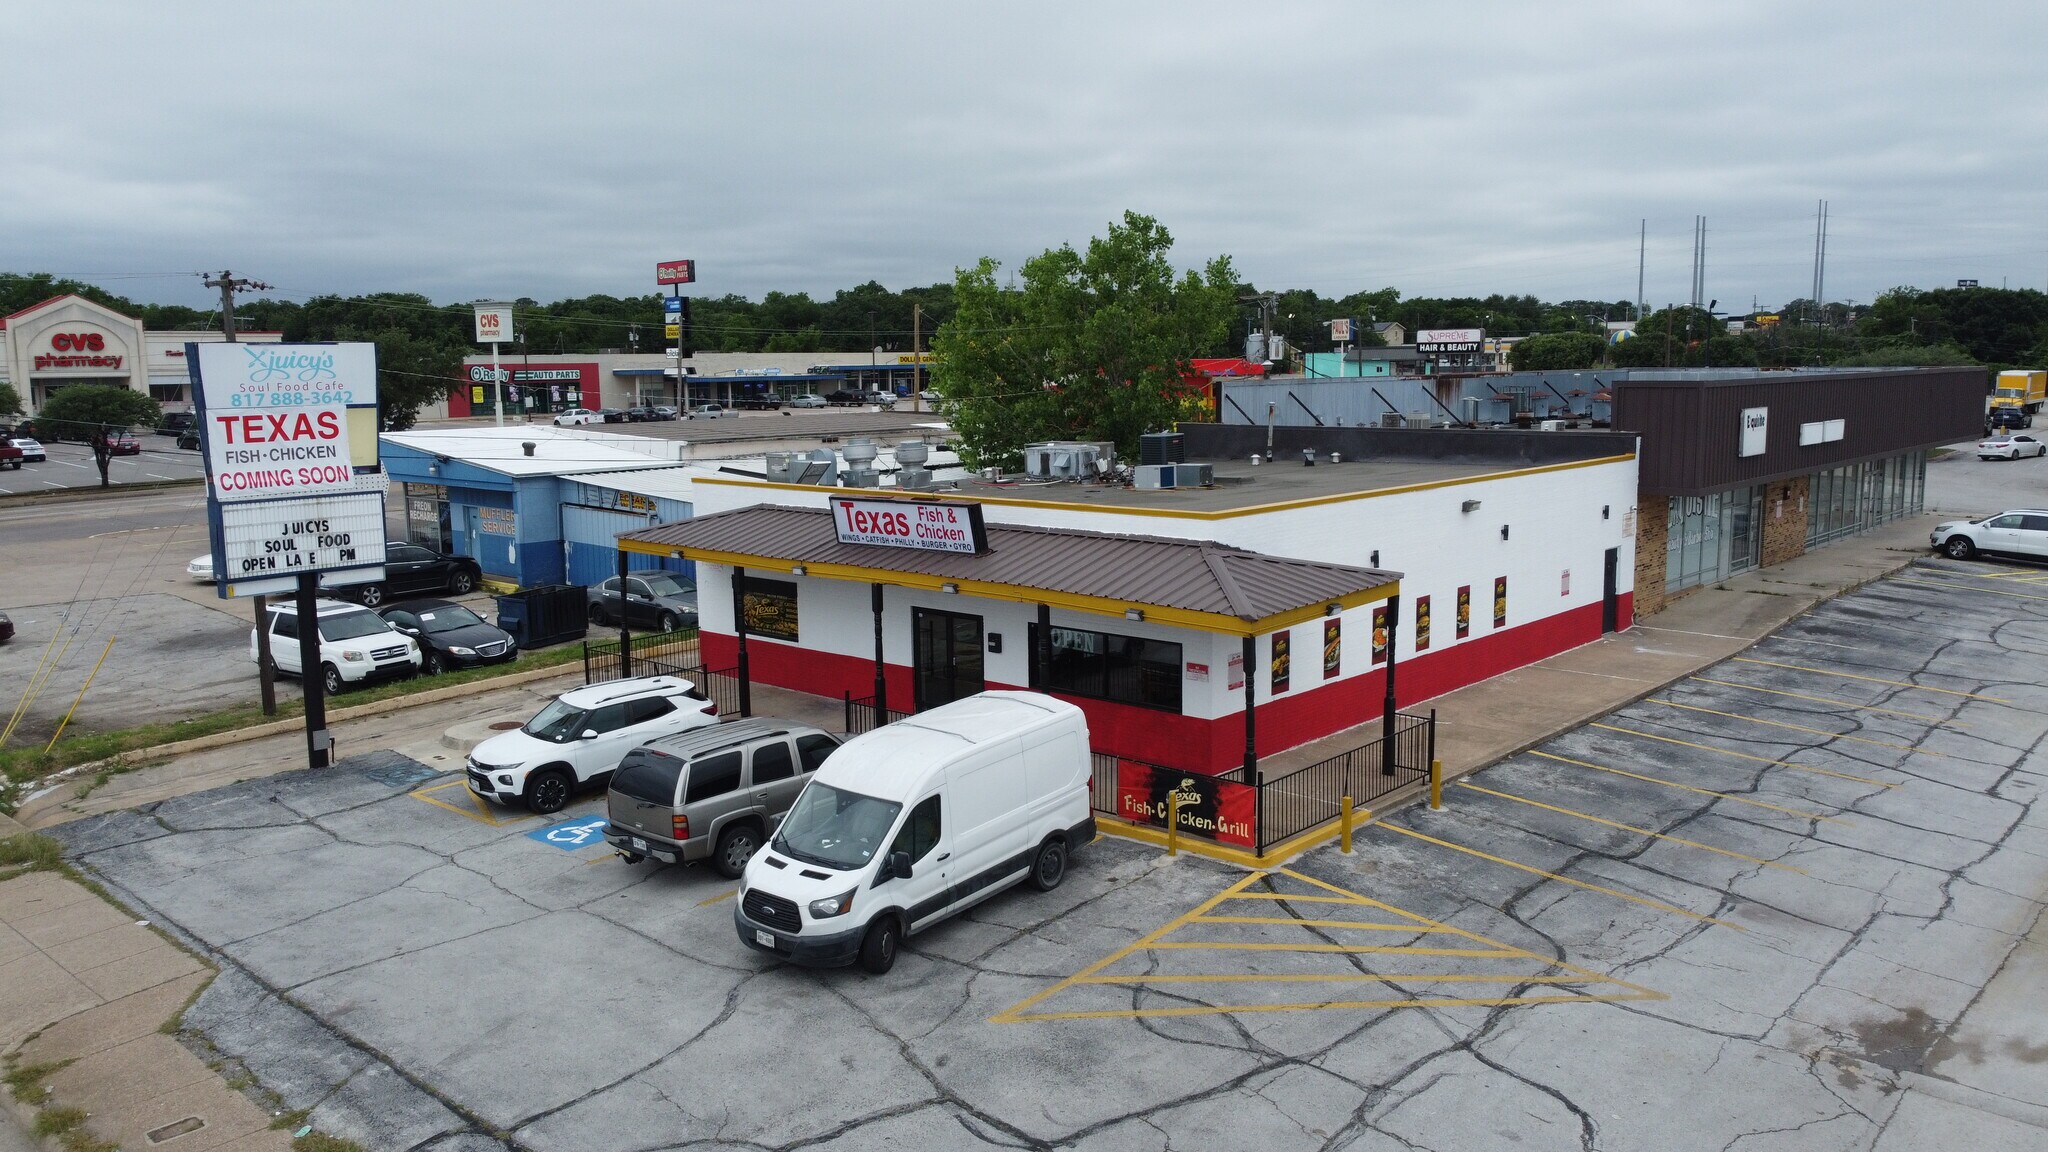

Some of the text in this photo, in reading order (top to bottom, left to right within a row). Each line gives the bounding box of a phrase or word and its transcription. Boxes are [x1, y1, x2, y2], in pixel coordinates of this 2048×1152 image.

[480, 314, 500, 328] CVS
[52, 333, 105, 351] CVS
[1427, 331, 1469, 342] SUPREME
[1447, 343, 1478, 351] BEAUTY
[34, 353, 123, 370] pharmacy
[250, 350, 337, 382] juicy's
[470, 366, 580, 382] O'Relly AUTO PARTS
[240, 381, 344, 392] Soul Food Cafe
[231, 391, 354, 407] 817 888-3642
[216, 411, 340, 444] TEXAS
[226, 445, 337, 464] FISH CHICKEN
[220, 465, 349, 491] COMING SOON
[414, 501, 432, 511] FREON
[480, 507, 515, 522] MUFFLER
[409, 510, 438, 522] RECHARGE
[840, 501, 957, 536] Texas Fish &
[282, 520, 329, 535] JUICYS
[482, 522, 516, 535] SERVICE
[916, 523, 965, 541] Chicken
[265, 534, 350, 553] SOUL FOOD
[841, 533, 972, 551] WINGS CATFISH PHILLY BURGER GYRO
[242, 556, 275, 571] OPEN
[340, 549, 356, 561] PM
[755, 604, 779, 616] Texas
[1050, 628, 1095, 653] OPEN
[1158, 802, 1212, 830] Cicken
[1218, 816, 1249, 838] Grill
